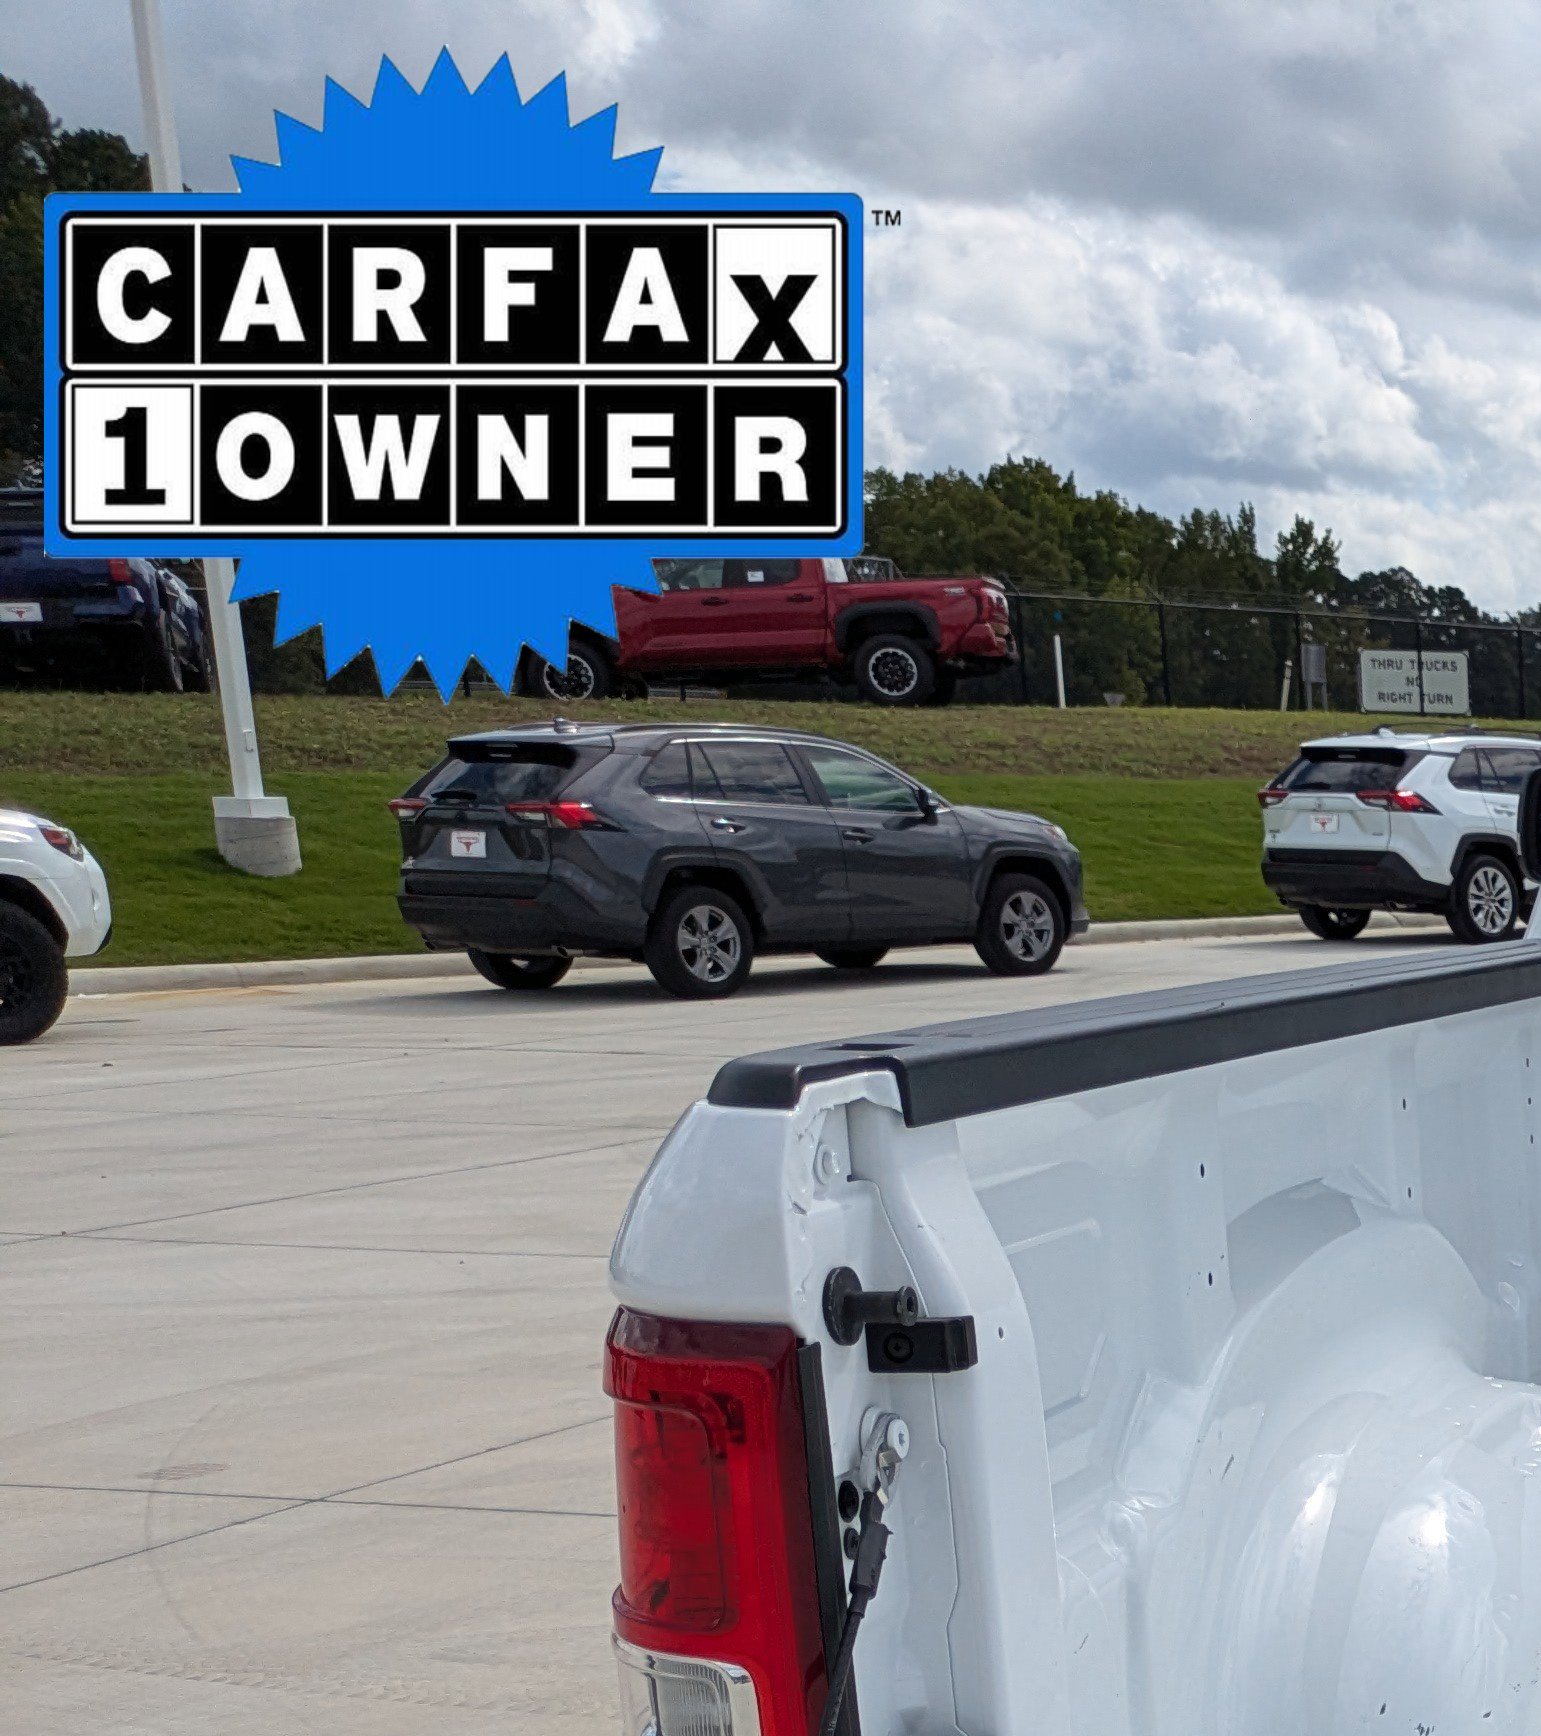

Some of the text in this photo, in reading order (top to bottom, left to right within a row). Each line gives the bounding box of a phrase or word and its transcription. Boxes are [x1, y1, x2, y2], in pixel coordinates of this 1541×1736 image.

[1370, 658, 1458, 672] THRU TUCKS
[1377, 691, 1413, 704] RIGHT
